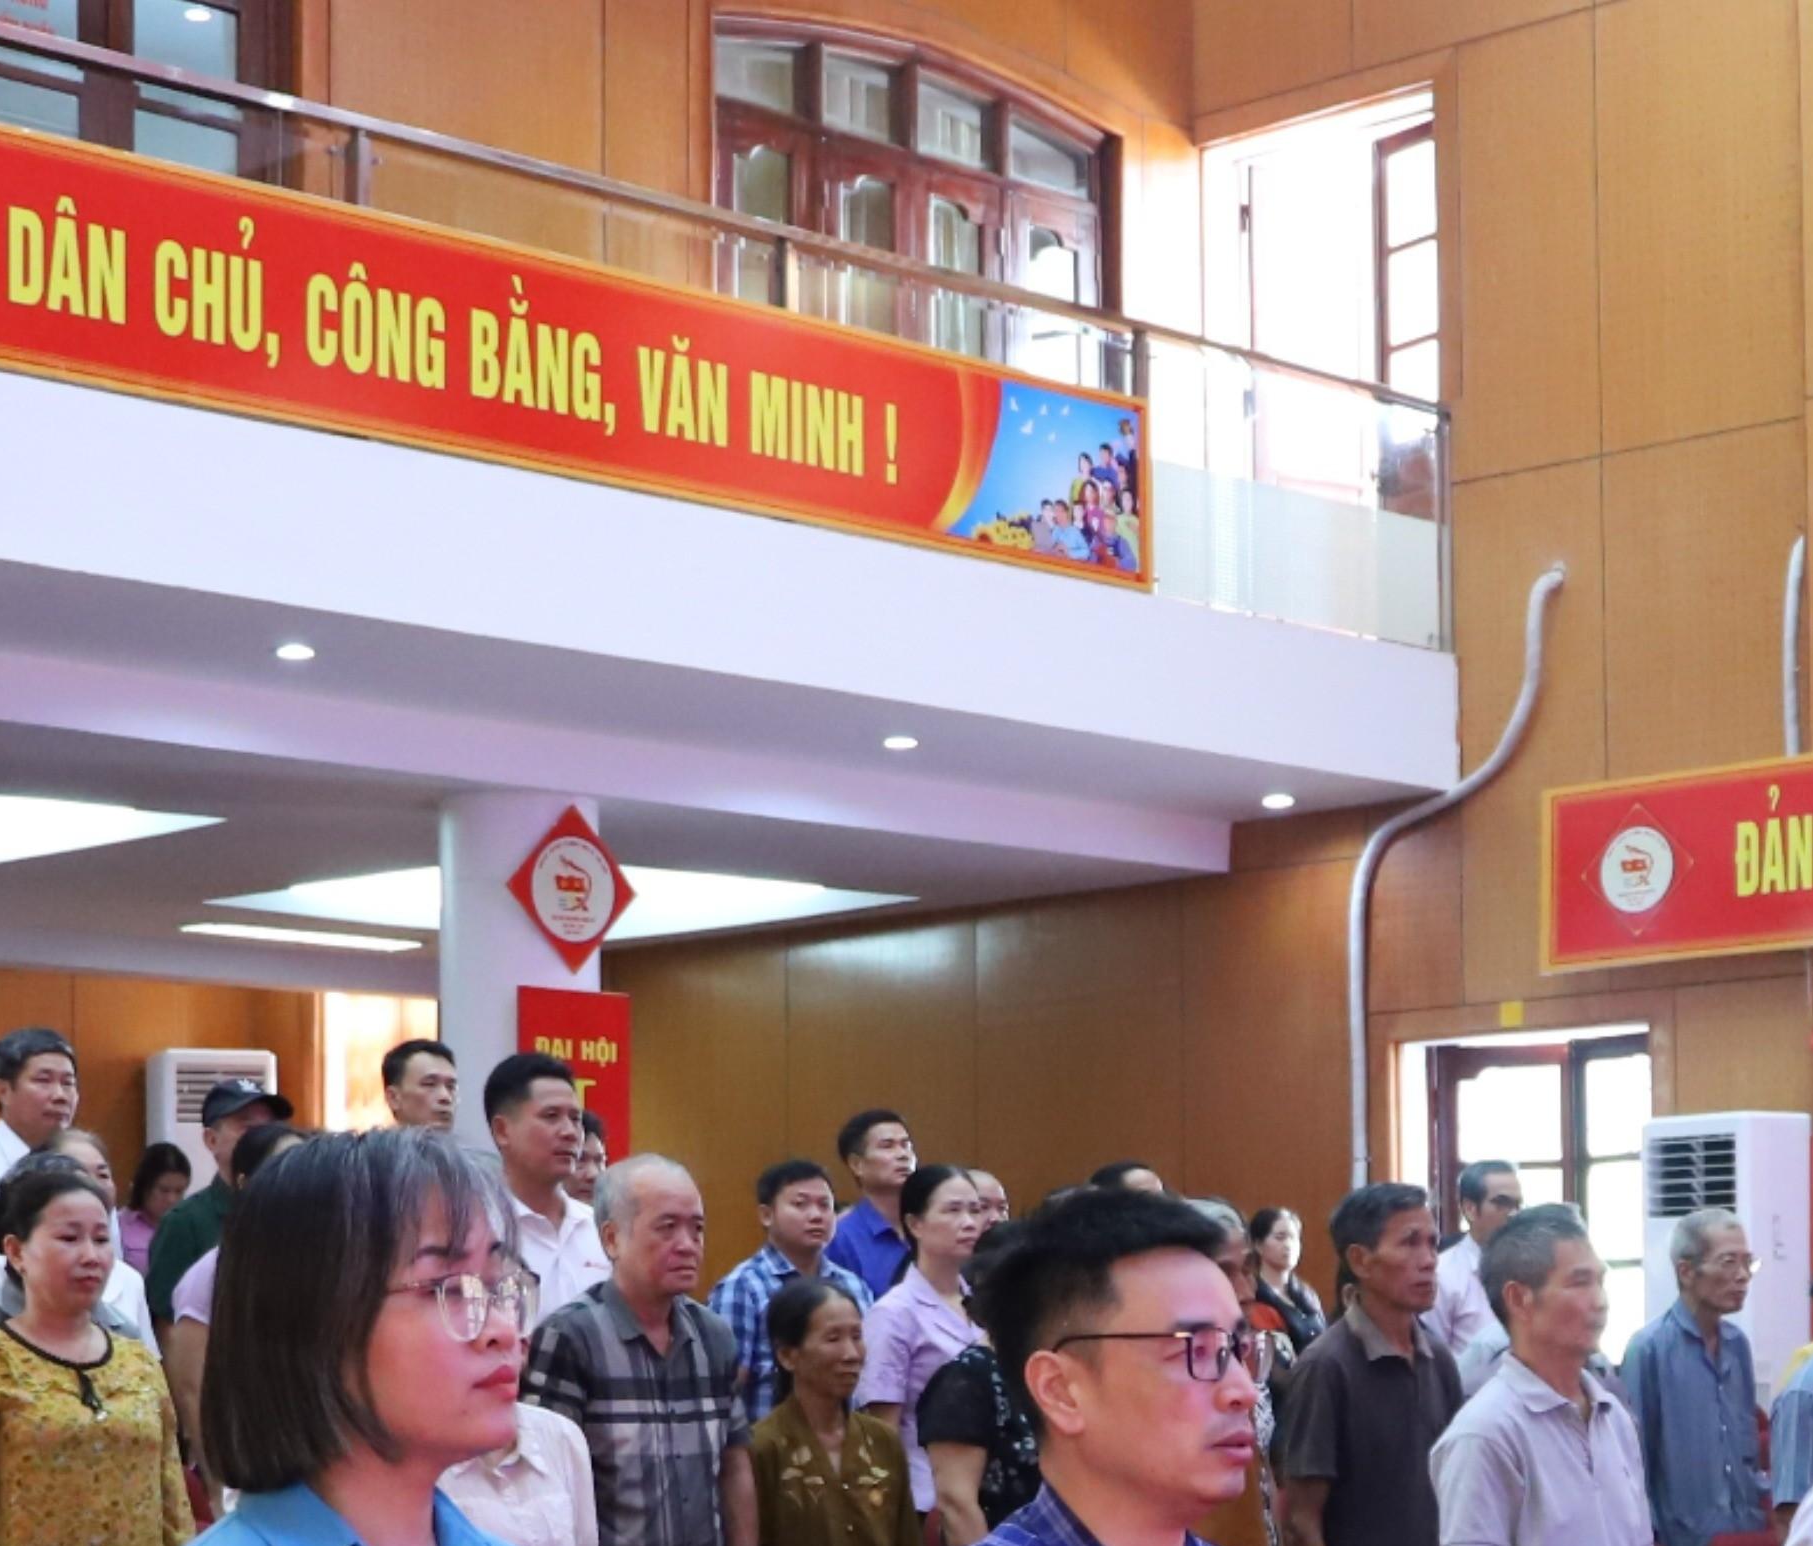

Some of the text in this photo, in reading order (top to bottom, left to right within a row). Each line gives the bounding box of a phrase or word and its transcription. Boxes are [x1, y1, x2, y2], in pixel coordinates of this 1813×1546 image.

[8, 196, 127, 324] DÂN
[153, 216, 280, 368] CHỦ,
[304, 262, 446, 391] CÔNG
[468, 274, 617, 437] BẰNG,
[637, 335, 729, 449] VĂN
[749, 371, 866, 477] MINH
[580, 1035, 619, 1068] HỘI
